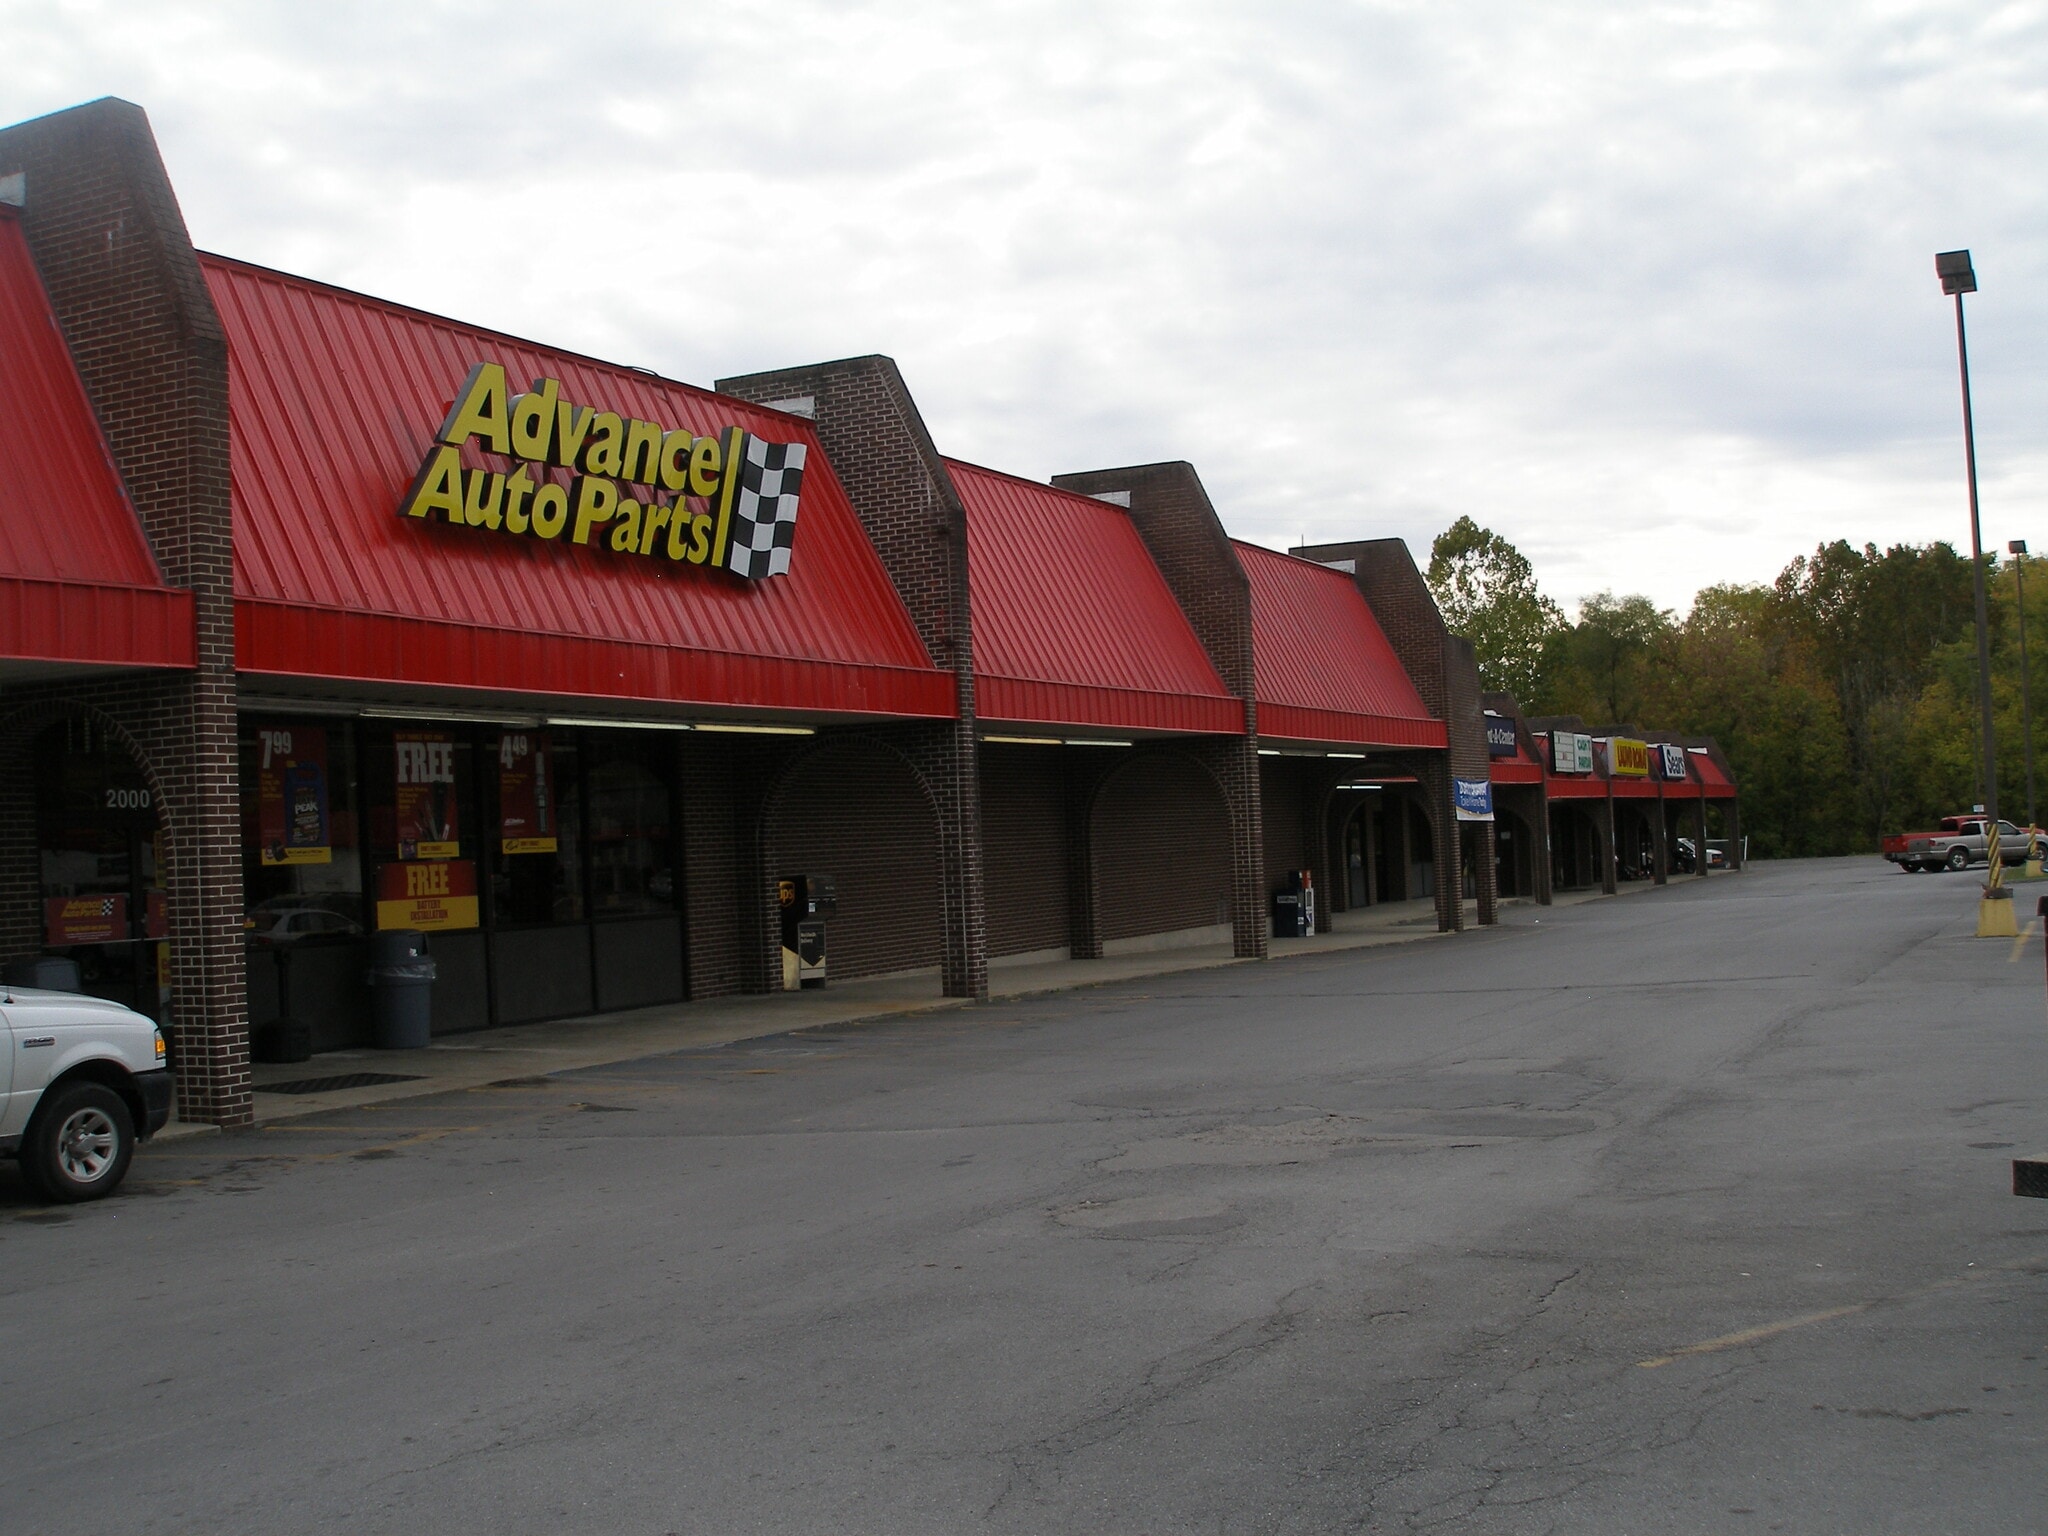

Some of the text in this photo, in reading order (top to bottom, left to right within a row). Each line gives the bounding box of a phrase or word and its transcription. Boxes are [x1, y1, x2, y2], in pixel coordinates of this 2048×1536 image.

[442, 362, 721, 496] Advance
[408, 446, 712, 564] Auto Parts
[1487, 728, 1515, 745] nt-A-Center
[396, 742, 454, 783] FREE
[1667, 749, 1685, 774] Sears
[106, 789, 151, 808] 2000
[294, 801, 319, 814] PEAK
[406, 863, 450, 896] FREE
